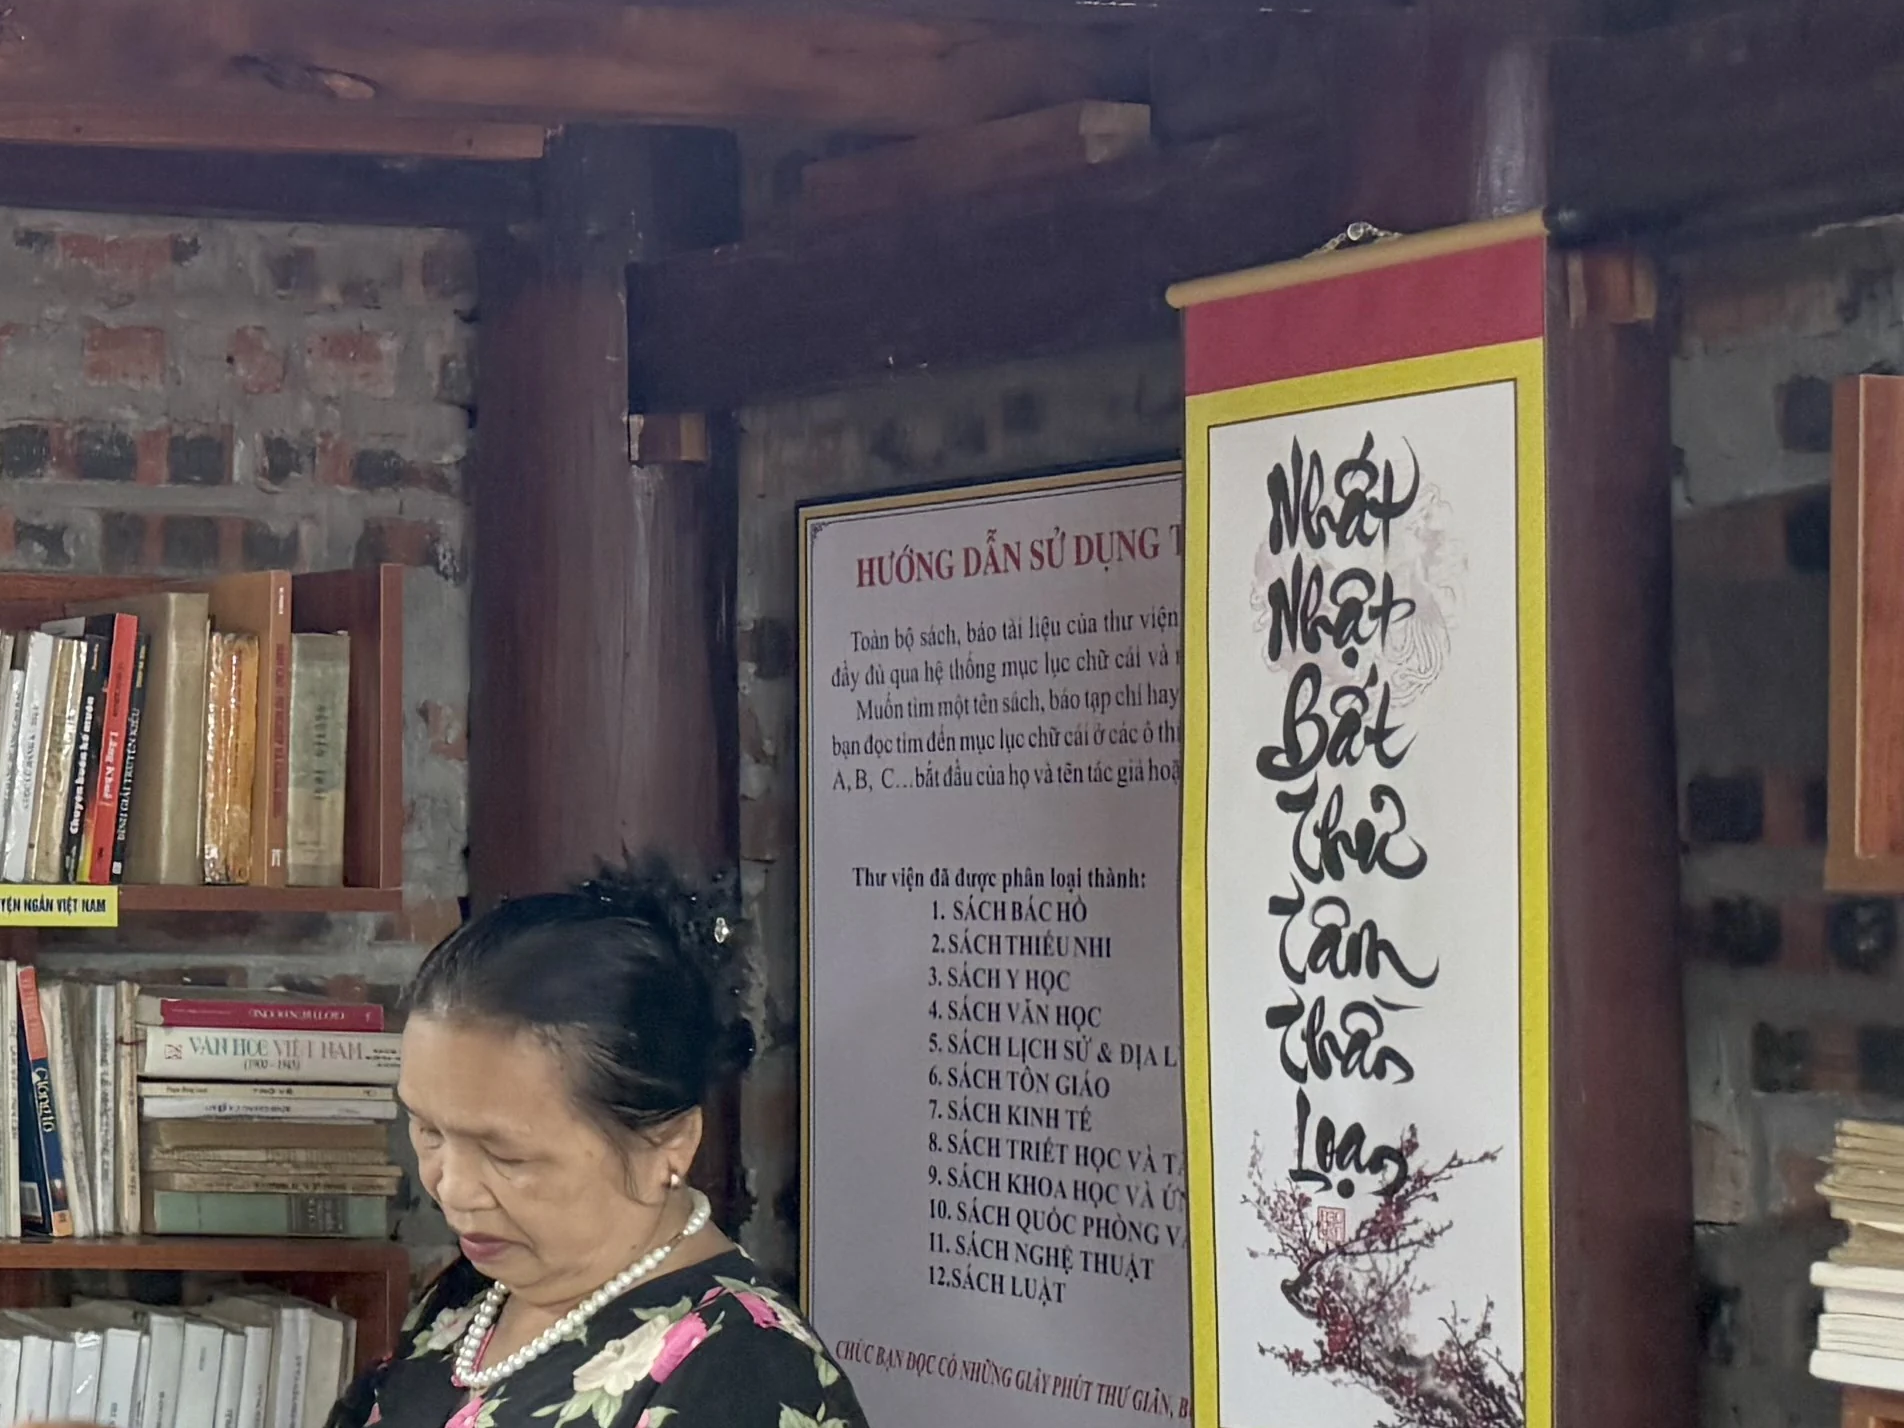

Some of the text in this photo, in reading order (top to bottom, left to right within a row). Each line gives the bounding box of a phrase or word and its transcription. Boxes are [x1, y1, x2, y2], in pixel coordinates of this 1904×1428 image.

[1268, 430, 1420, 555] Nhất
[857, 545, 953, 588] HƯỚNG
[963, 529, 1021, 577] DẪN
[1030, 527, 1065, 571] SỬ
[1074, 527, 1159, 571] DỤNG
[851, 605, 1178, 651] Toàn bộ sách, báo tài liệu của thư viện
[1268, 552, 1416, 669] Nhật
[1256, 662, 1418, 782] Bất
[853, 867, 1146, 893] Thư viện đã được phân loại thành:
[24, 892, 53, 912] NGẮN
[57, 896, 77, 915] VIỆT
[82, 899, 106, 912] NAM
[953, 894, 1087, 922] SÁCH BÁC HỒ
[948, 928, 1111, 958] SÁCH THIẾU NHI
[1269, 872, 1439, 988] Tâm
[948, 962, 1071, 996] SÁCH Y HỌC
[948, 994, 1102, 1032] SÁCH VĂN HỌC
[1266, 986, 1424, 1084] Thần
[948, 1029, 1157, 1071] SÁCH LỊCH SỬ & ĐỊA
[948, 1062, 1110, 1098] SÁCH TÔN GIÁO
[948, 1095, 1092, 1132] SÁCH KINH TẾ
[948, 1129, 1000, 1157] SÁCH
[1007, 1136, 1068, 1164] TRIẾT
[1075, 1144, 1120, 1172] HỌC
[1128, 1144, 1156, 1173] VÀ
[1289, 1086, 1408, 1199] Loạn
[948, 1162, 1000, 1192] SÁCH
[1008, 1173, 1067, 1199] KHOA
[1073, 1179, 1118, 1208] HỌC
[1126, 1179, 1154, 1209] VÀ
[957, 1197, 1009, 1226] SÁCH
[1017, 1206, 1076, 1235] QUỐC
[1084, 1213, 1159, 1245] PHÒNG
[955, 1230, 1154, 1283] SÁCH NGHỆ THUẬT
[1012, 1275, 1065, 1306] LUẬT
